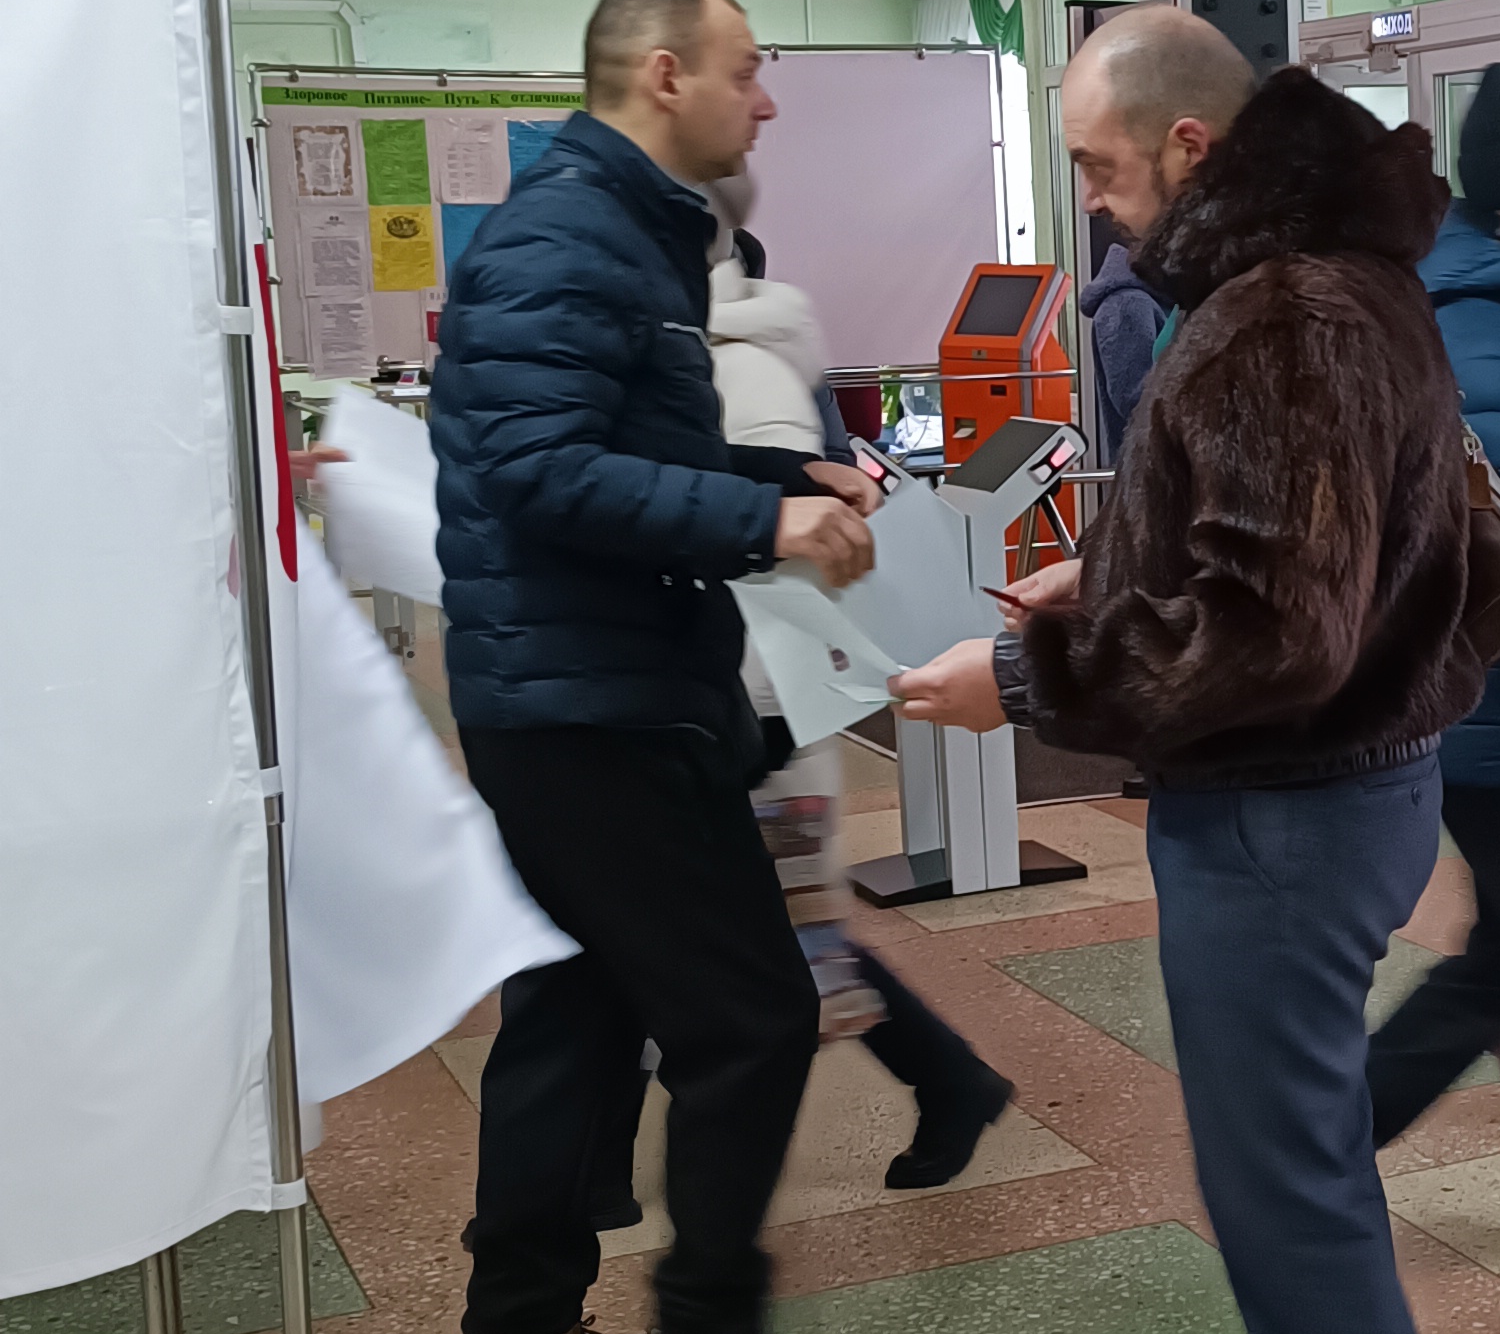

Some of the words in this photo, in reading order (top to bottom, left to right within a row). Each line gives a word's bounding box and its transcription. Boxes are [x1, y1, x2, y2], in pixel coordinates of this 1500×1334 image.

[283, 87, 348, 103] Здоровое
[364, 91, 432, 105] Питание-
[445, 92, 480, 108] Путь
[490, 93, 500, 105] К
